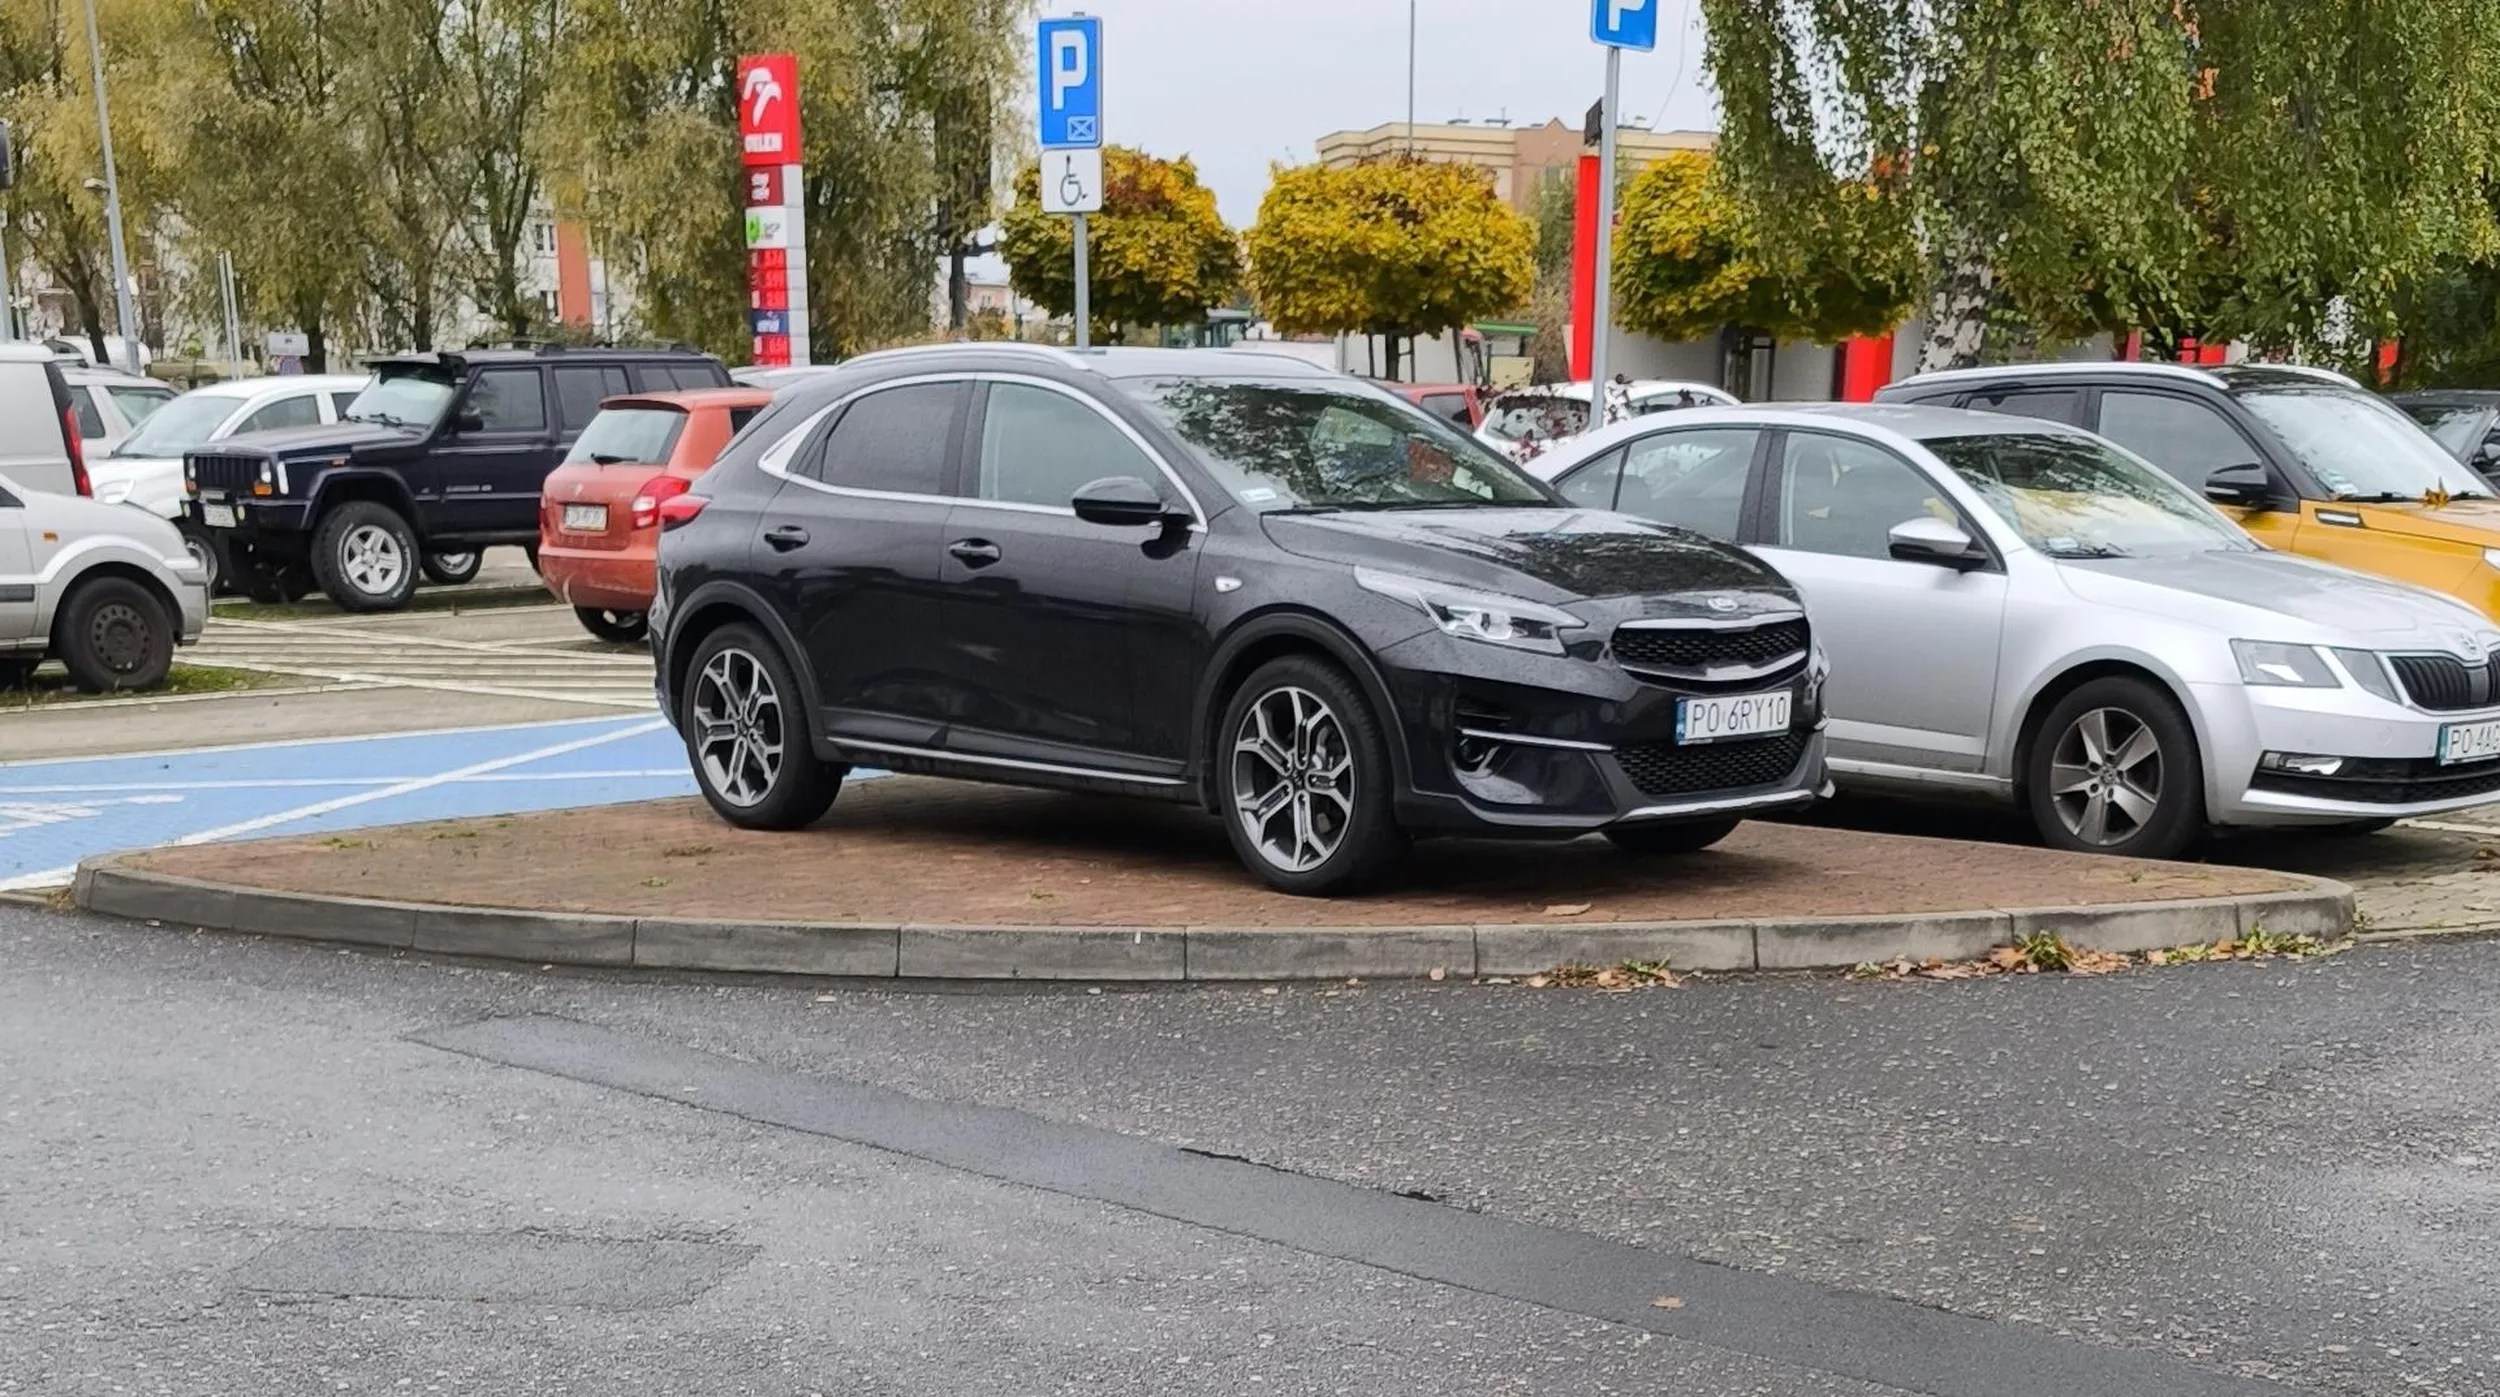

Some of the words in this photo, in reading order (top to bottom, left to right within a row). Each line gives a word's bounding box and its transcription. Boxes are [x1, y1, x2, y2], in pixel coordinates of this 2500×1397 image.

[1050, 29, 1089, 110] P
[1691, 702, 1720, 735] PO
[1727, 696, 1787, 731] 6RY10
[2451, 729, 2473, 756] PO
